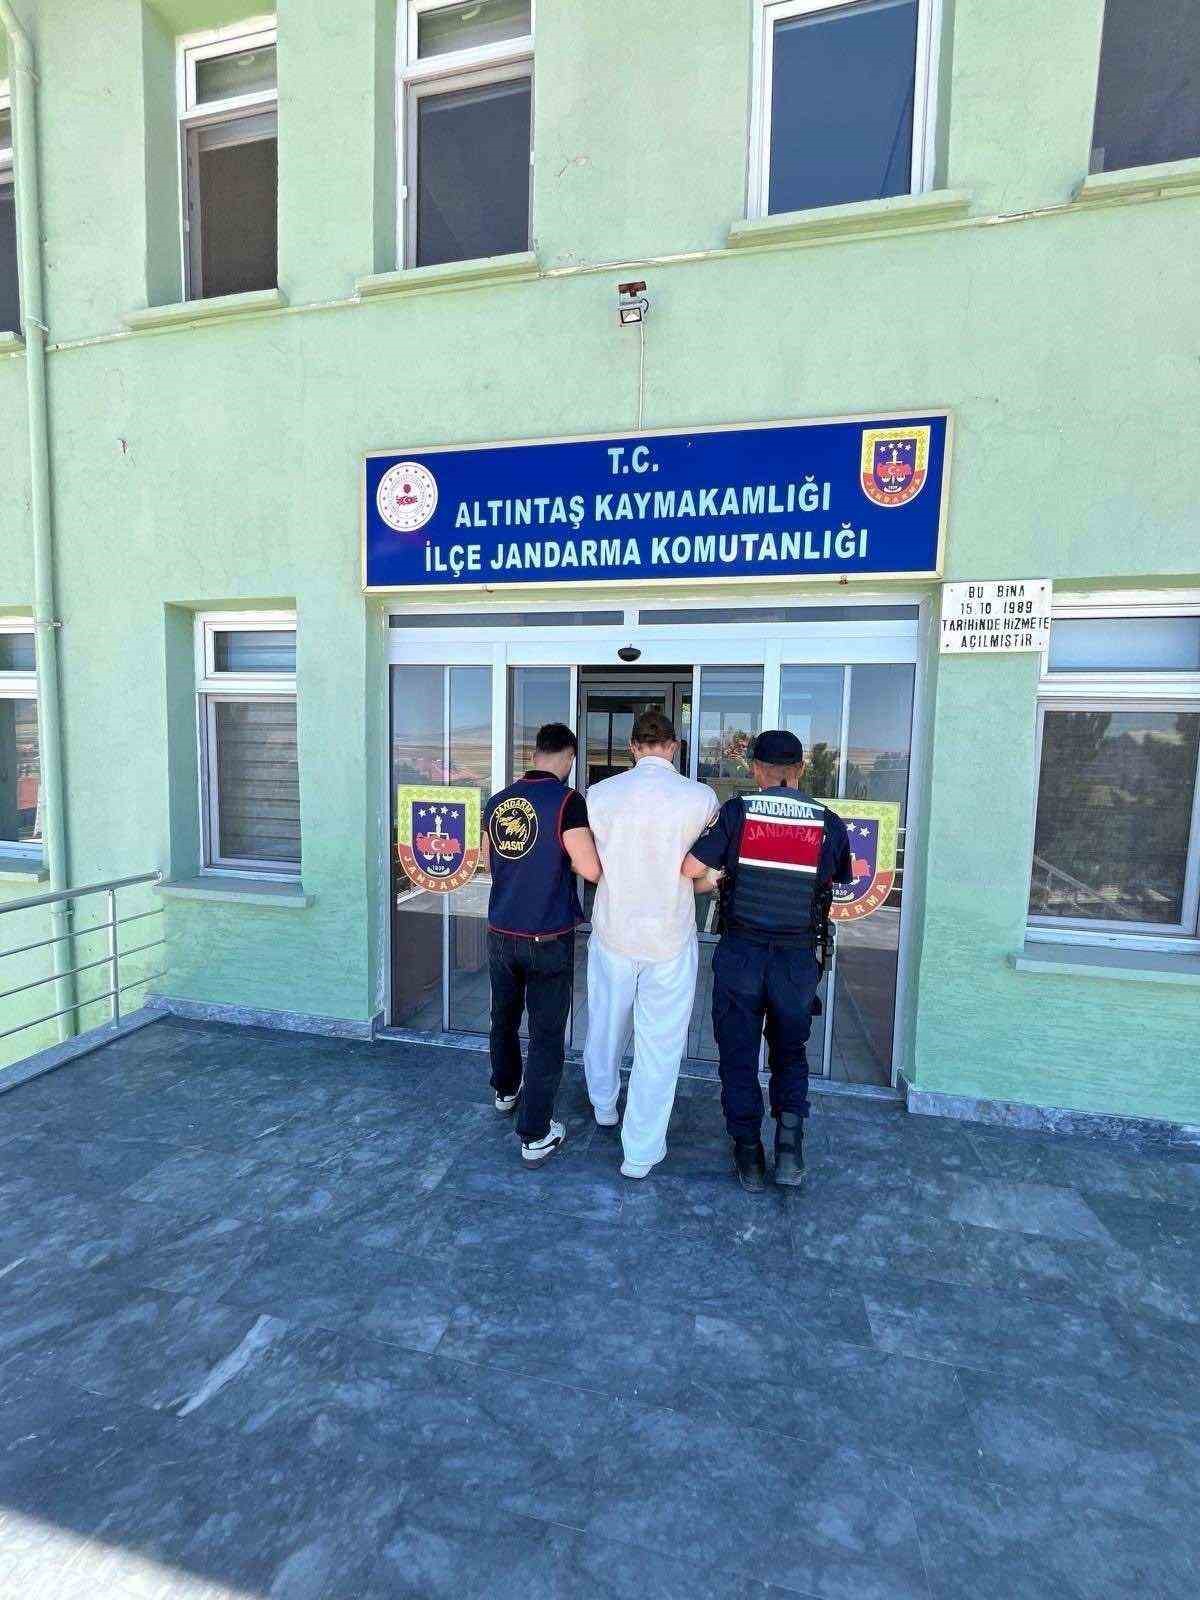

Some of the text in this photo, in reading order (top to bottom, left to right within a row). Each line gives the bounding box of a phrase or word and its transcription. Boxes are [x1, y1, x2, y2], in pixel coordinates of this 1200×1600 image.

[608, 446, 659, 475] T.C.
[455, 495, 586, 530] ALTINTAŞ
[594, 476, 831, 522] KAYMAKAMLIĞI
[425, 522, 869, 578] İLÇE JANDARMA KOMUTANLIĞI
[968, 586, 984, 599] BU
[1003, 600, 1033, 614] 1989
[495, 800, 535, 820] JANDARMA
[748, 800, 815, 818] JANDARMA
[498, 841, 525, 851] JASAT
[405, 855, 475, 890] JANDARMA
